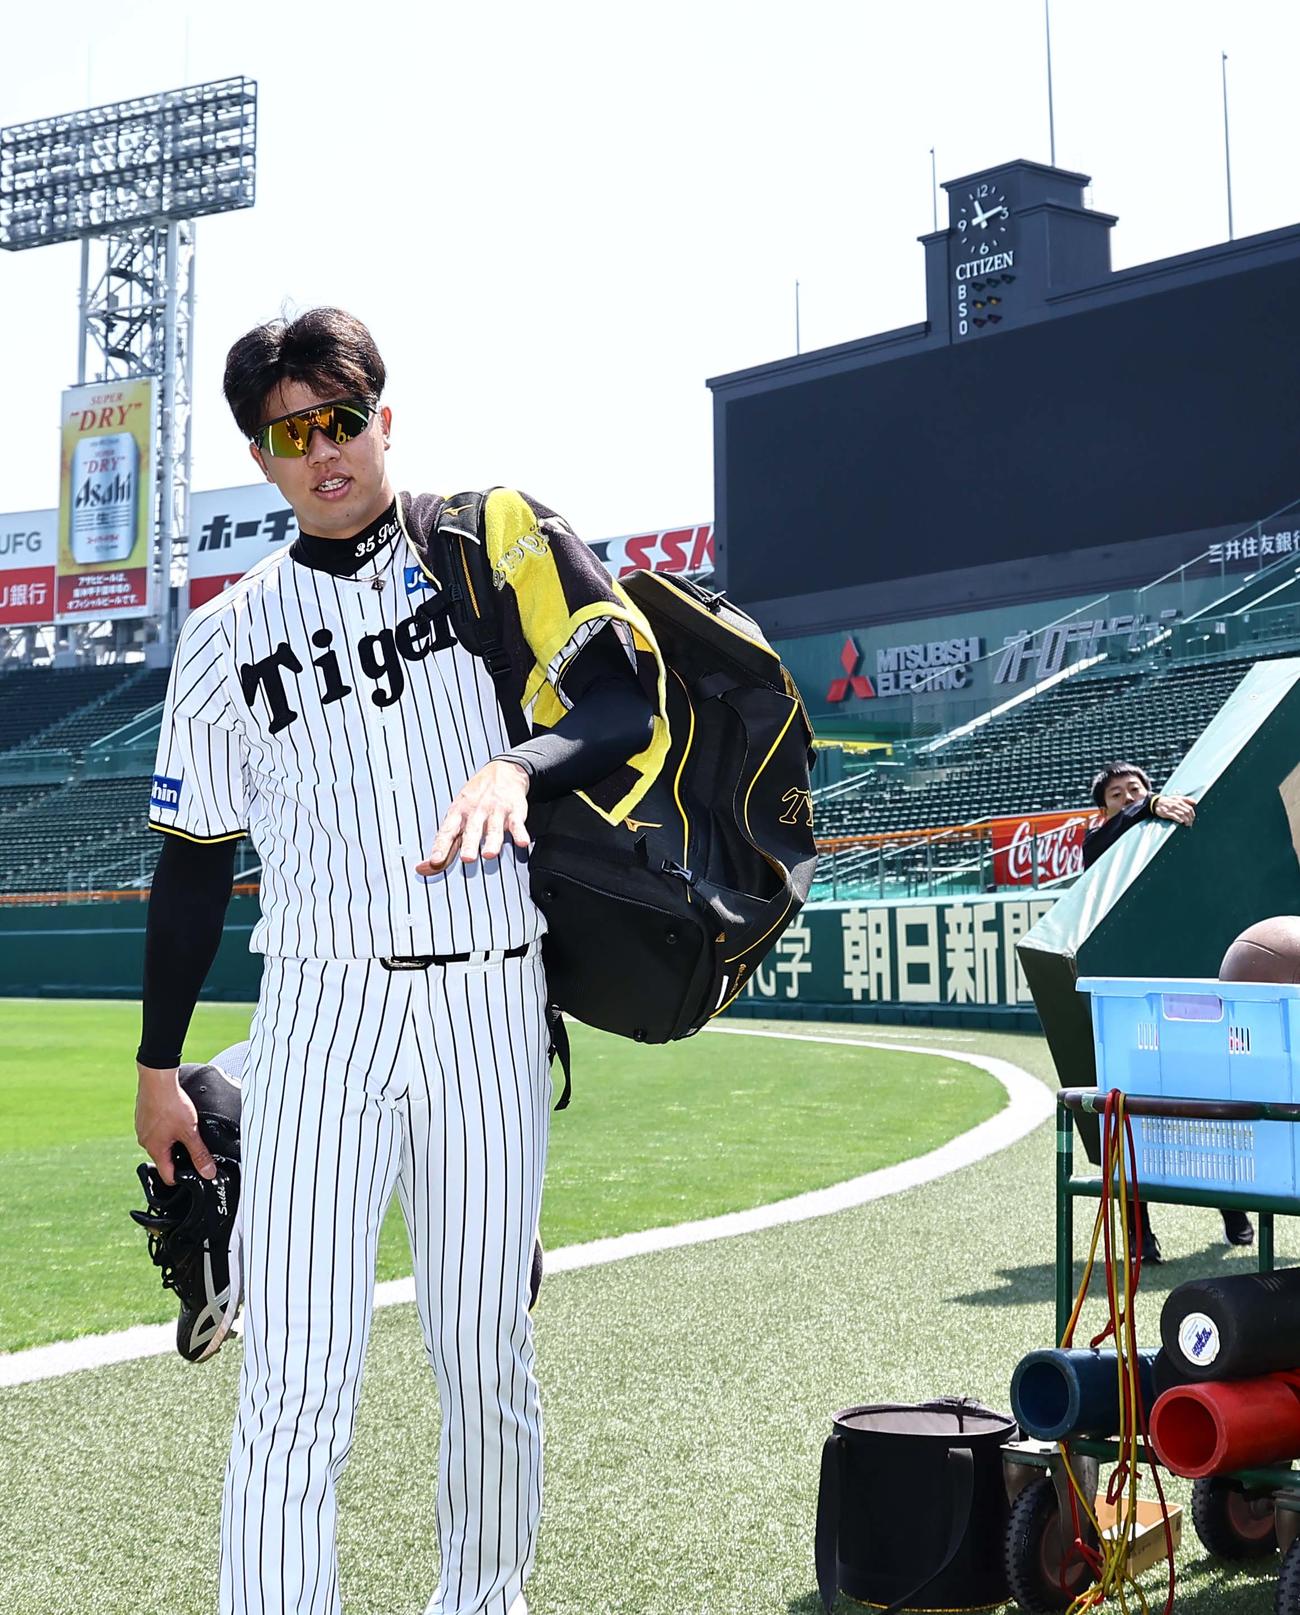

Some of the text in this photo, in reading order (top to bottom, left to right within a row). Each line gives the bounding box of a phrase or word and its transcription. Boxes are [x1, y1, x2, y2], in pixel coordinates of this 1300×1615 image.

[977, 184, 988, 198] 12
[1000, 207, 1009, 220] 3
[958, 220, 967, 232] 9
[979, 243, 989, 255] 6
[956, 251, 1014, 281] CITIZEN
[958, 284, 967, 300] B
[958, 302, 968, 317] S
[91, 392, 123, 405] SUPER
[75, 471, 131, 509] Asahi
[197, 507, 296, 552] ホーチ
[355, 512, 399, 557] 35 Sai
[619, 525, 716, 577] SSK
[877, 637, 979, 672] MITSUBISHI
[877, 665, 967, 697] ELECTRIC
[152, 781, 178, 803] hin
